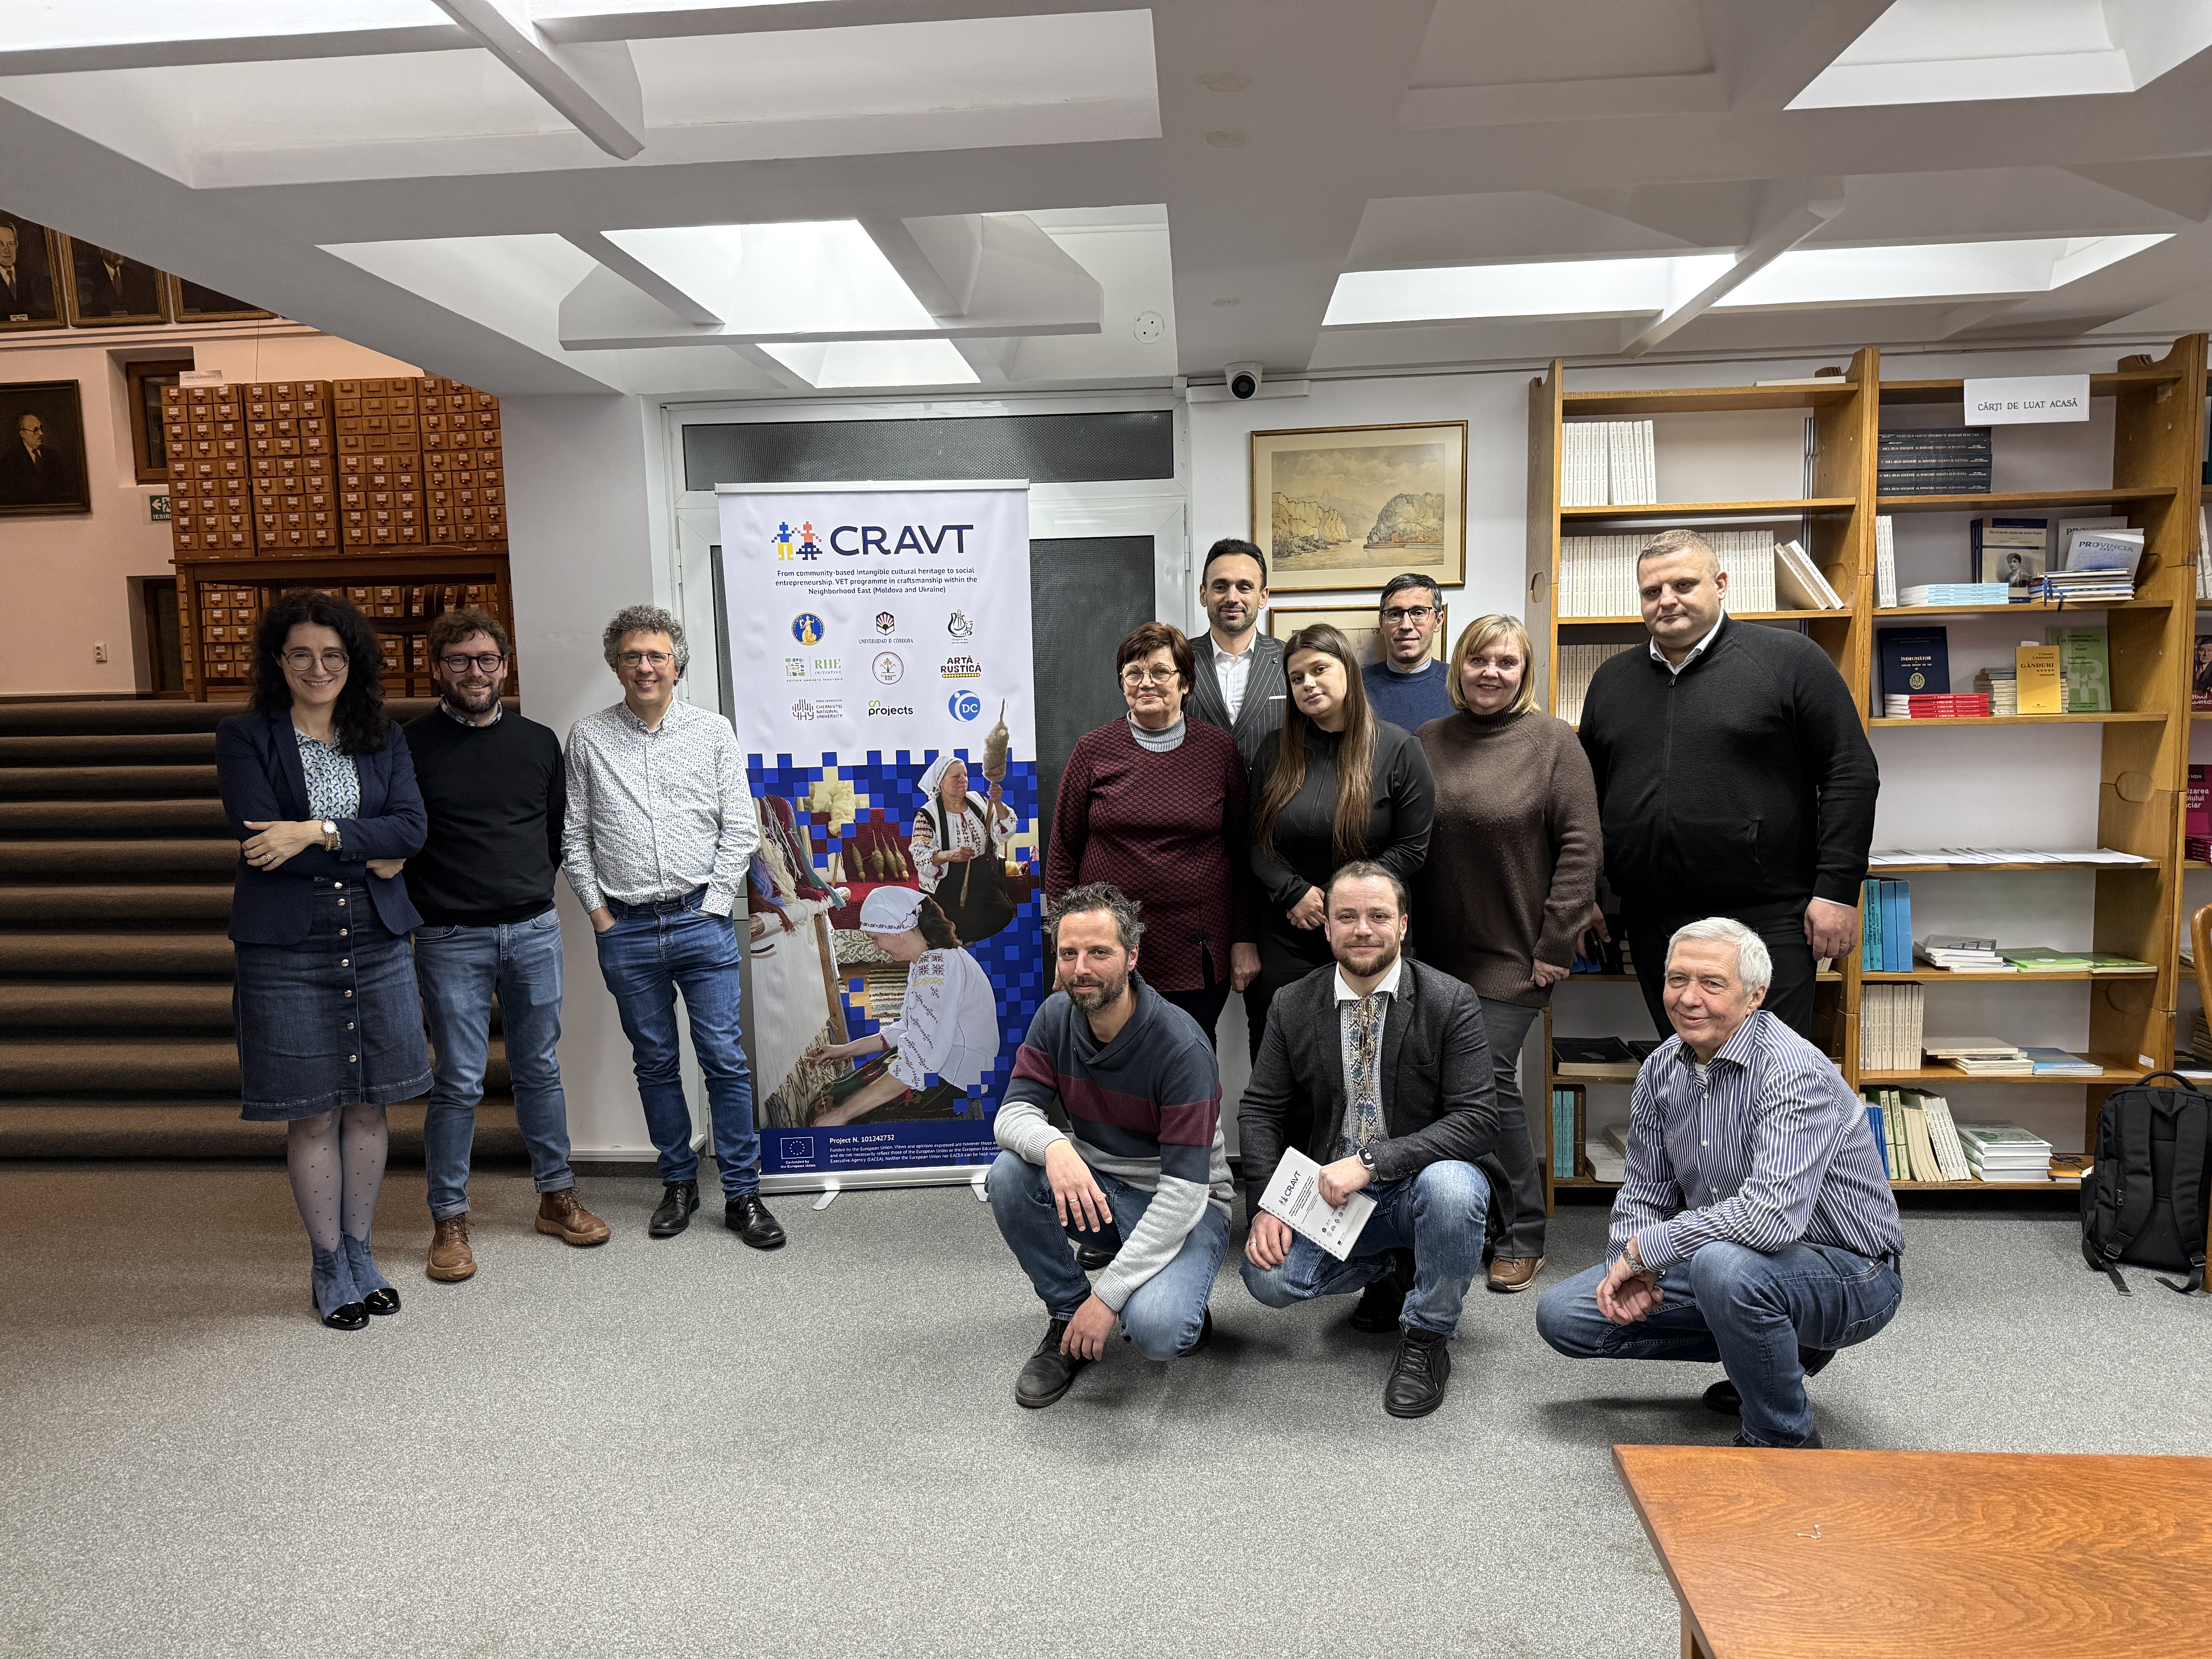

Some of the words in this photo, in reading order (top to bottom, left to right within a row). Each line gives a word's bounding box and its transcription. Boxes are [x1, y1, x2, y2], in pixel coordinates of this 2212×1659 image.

[2024, 401, 2046, 409] LUAT
[2049, 398, 2078, 408] ACASĂ
[830, 524, 974, 556] CRAVT
[2079, 541, 2133, 552] PROVINCIA
[808, 587, 855, 596] Neighborhood
[814, 659, 841, 669] RHE
[947, 655, 973, 665] ARTĂ
[941, 663, 981, 673] RUSTICĂ
[869, 706, 913, 716] projects
[962, 704, 978, 713] DC
[861, 1135, 895, 1143] 101242732
[1285, 1170, 1301, 1196] CRAVT
